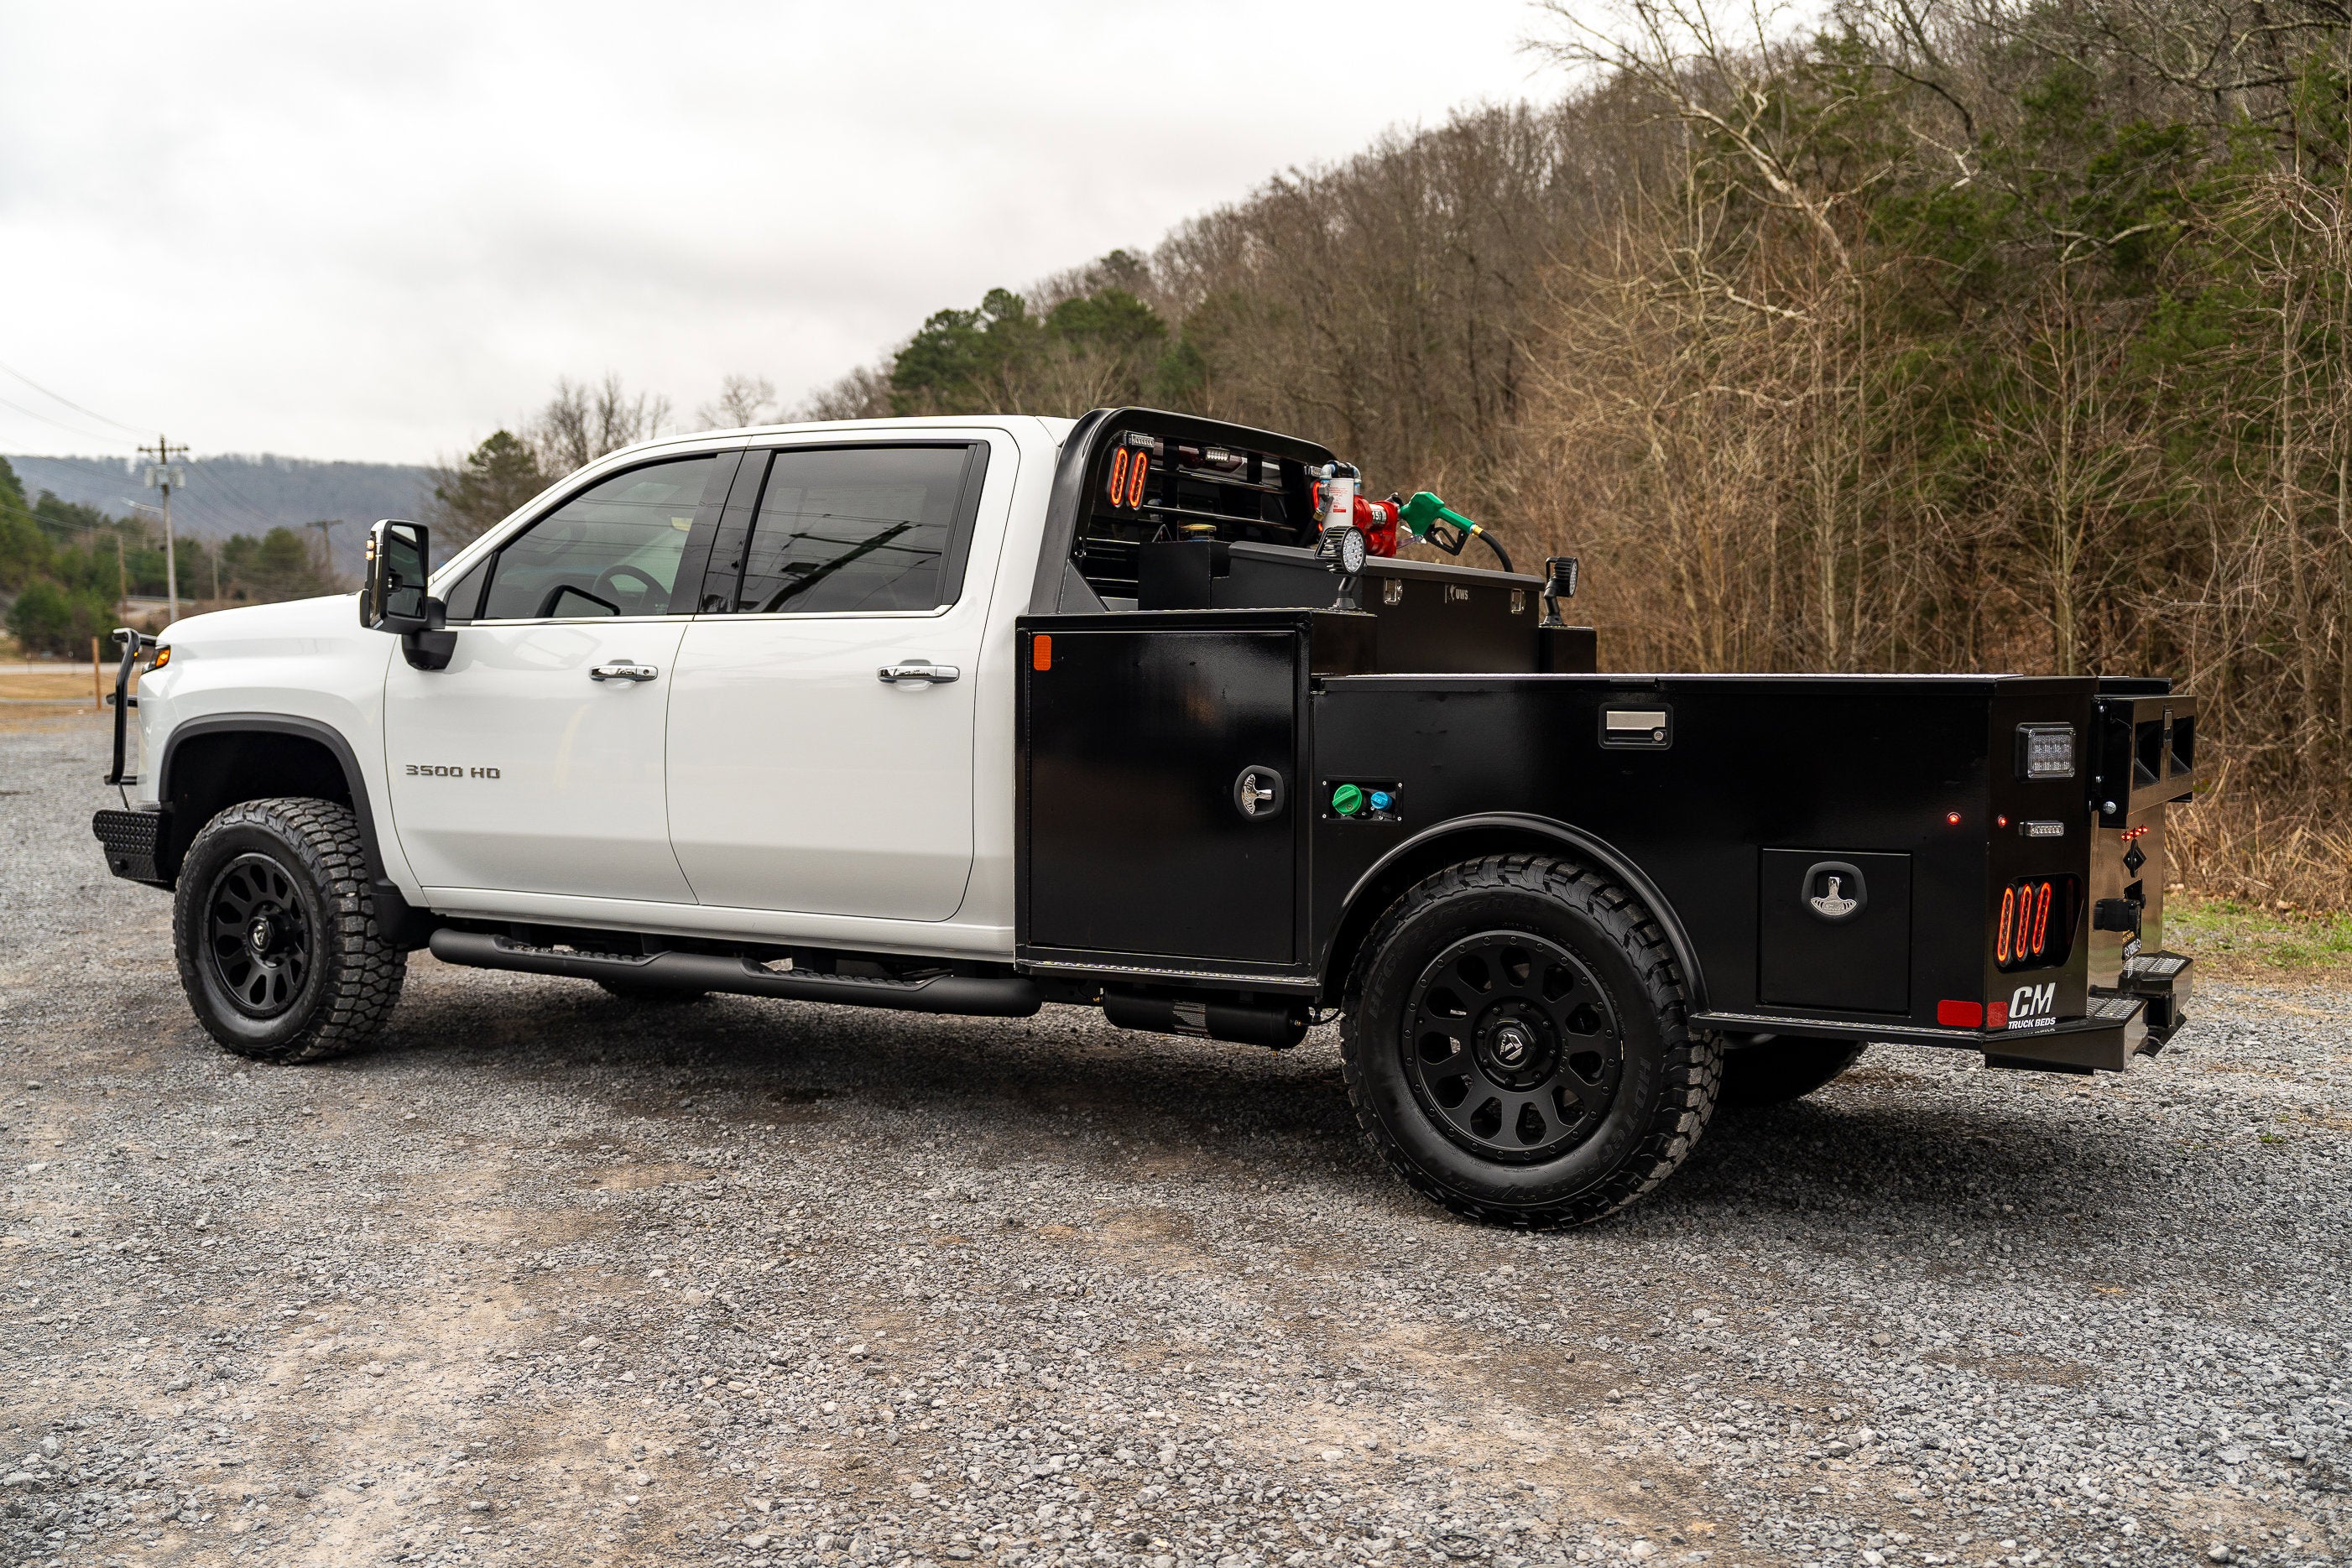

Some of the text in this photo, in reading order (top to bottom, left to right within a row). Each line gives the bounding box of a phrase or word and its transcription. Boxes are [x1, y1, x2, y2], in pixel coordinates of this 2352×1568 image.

[1455, 588, 1468, 600] UWS
[405, 764, 501, 779] 3500 HD
[2009, 982, 2056, 1018] CM
[2008, 1016, 2057, 1029] TRUCK BEDS
